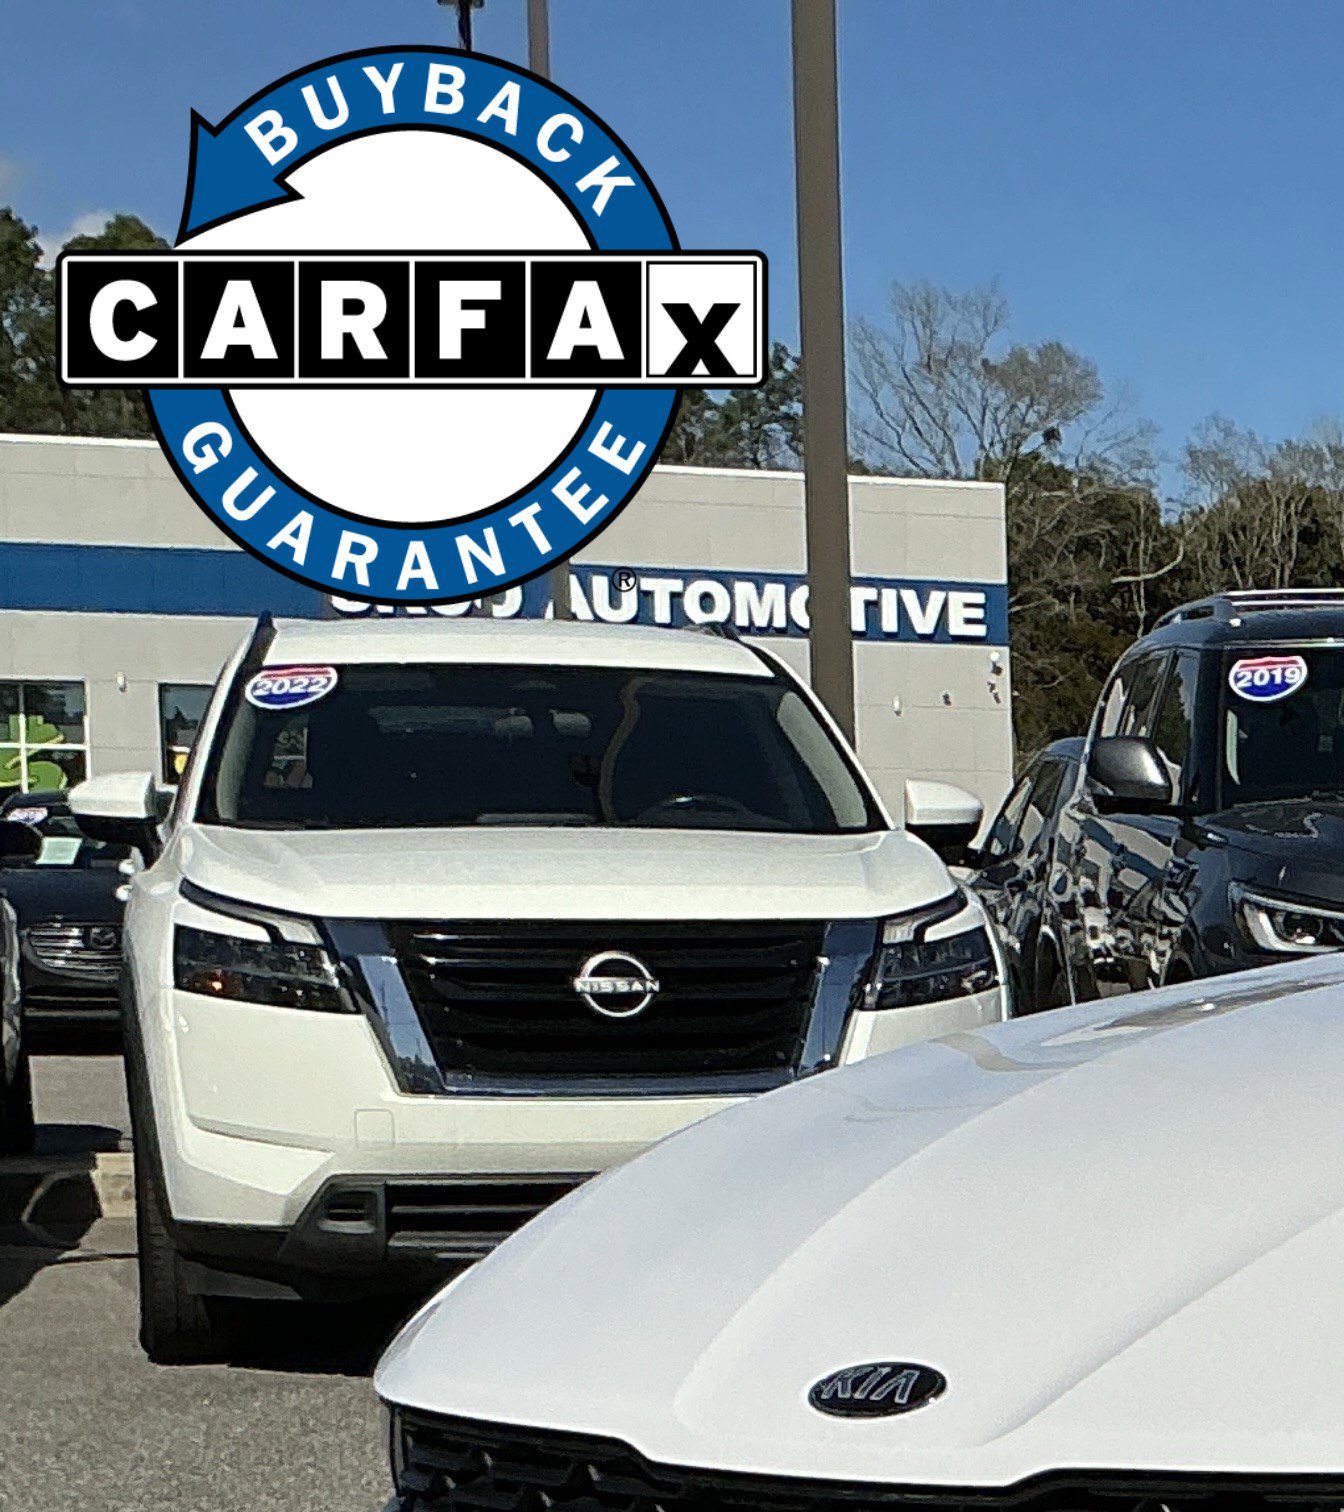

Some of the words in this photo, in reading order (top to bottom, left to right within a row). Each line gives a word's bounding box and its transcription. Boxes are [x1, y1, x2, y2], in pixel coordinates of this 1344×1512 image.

[252, 676, 328, 696] 2022
[1236, 666, 1301, 688] 2019
[574, 977, 660, 993] NISSAN
[820, 1366, 920, 1404] KIA
